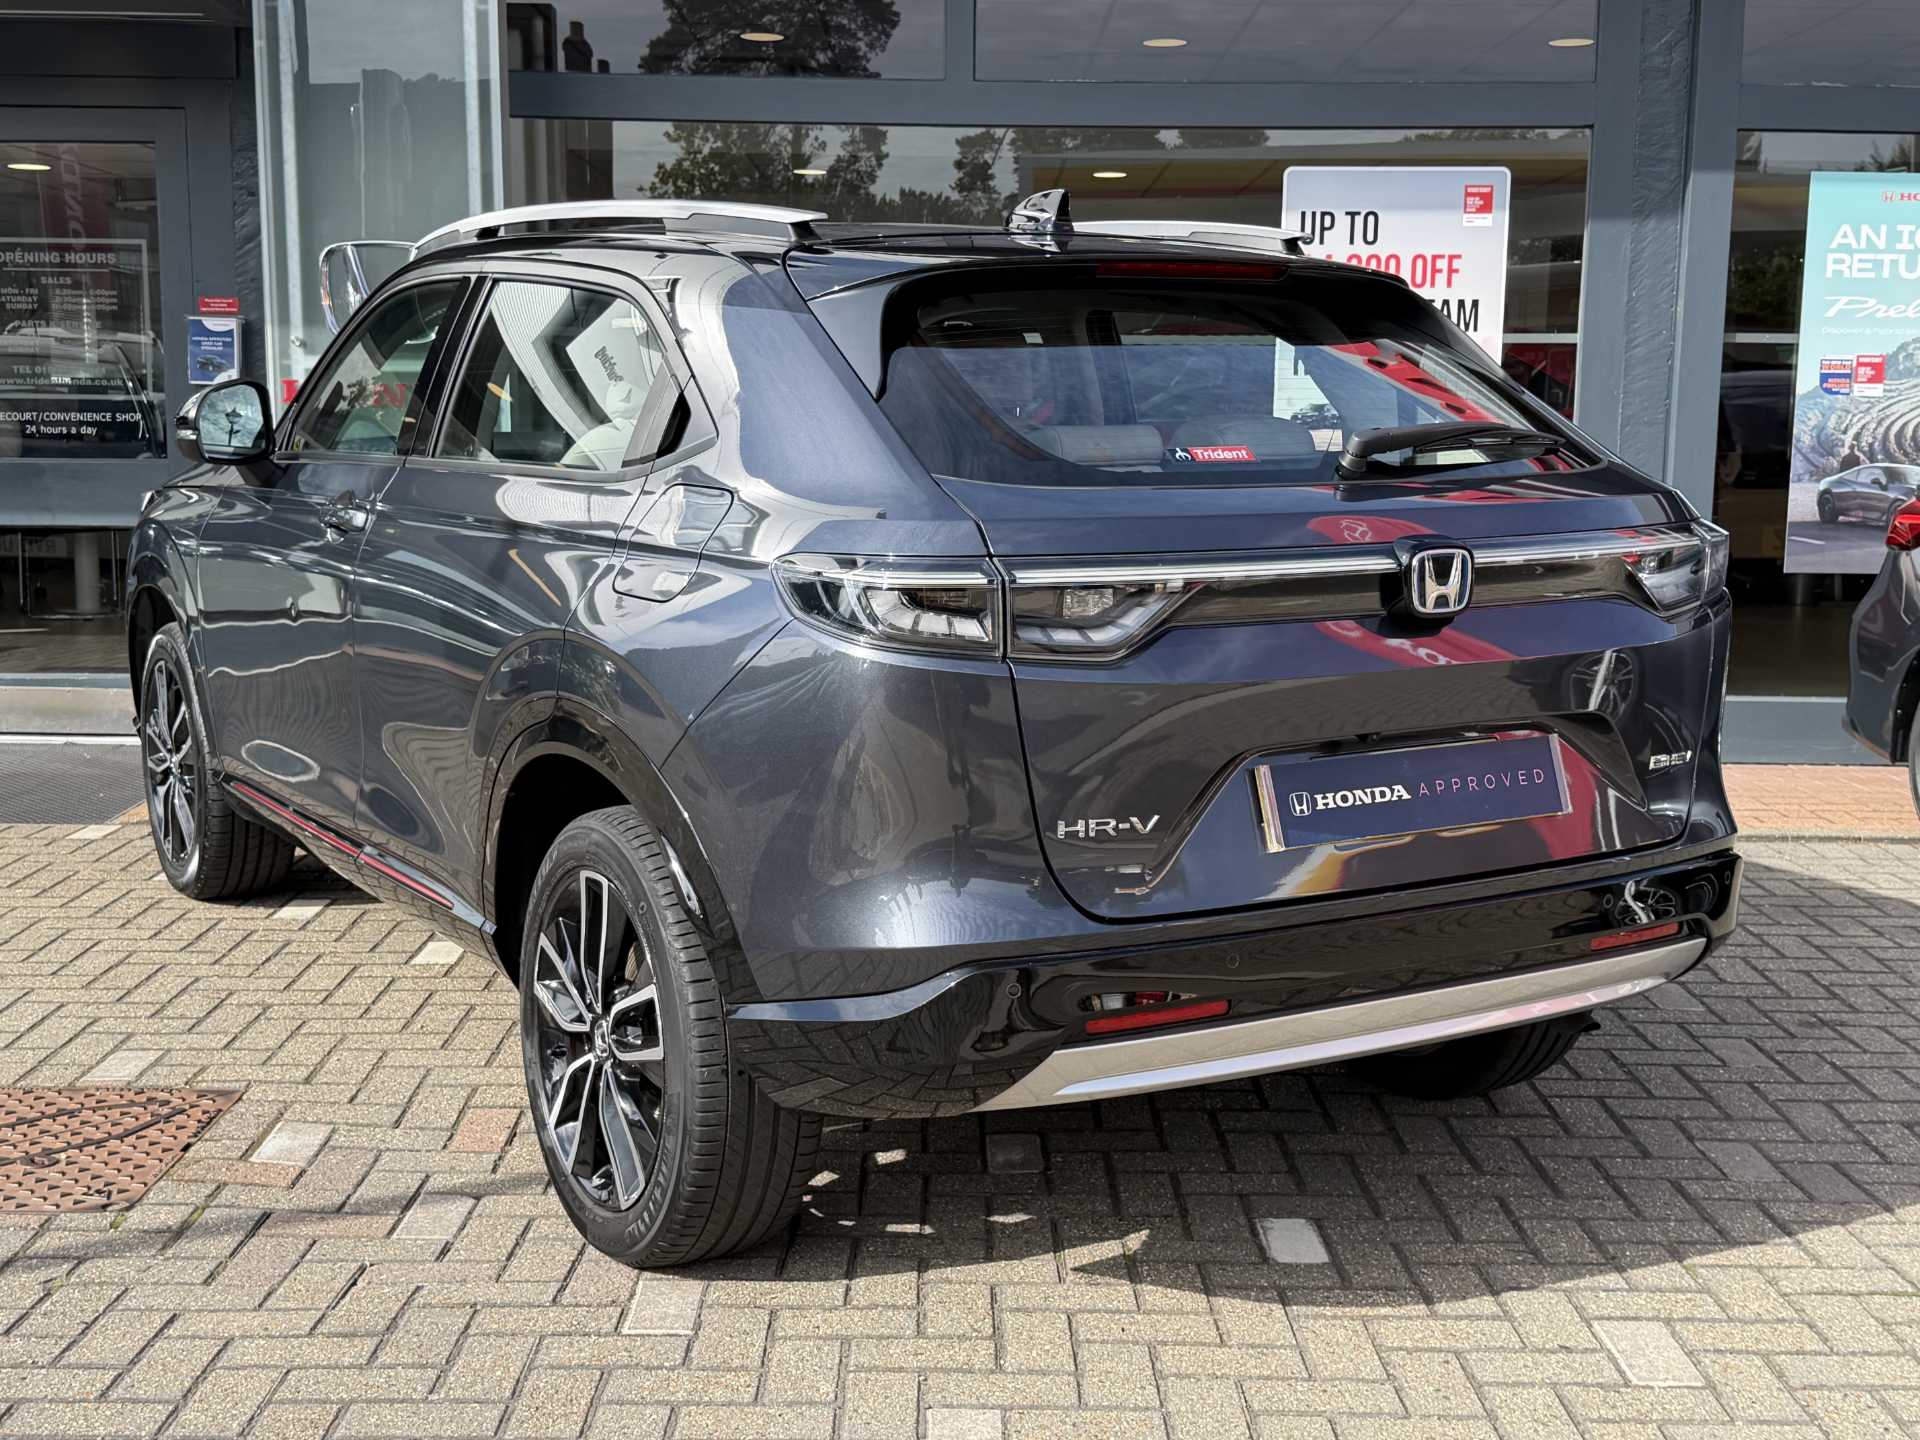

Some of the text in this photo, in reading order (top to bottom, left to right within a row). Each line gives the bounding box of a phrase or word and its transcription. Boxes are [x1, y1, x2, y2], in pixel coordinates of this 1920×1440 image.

[1300, 211, 1380, 246] UP TO
[1828, 223, 1888, 250] AN
[65, 252, 118, 265] HOURS
[40, 276, 73, 285] SALES
[1410, 254, 1463, 289] OFF
[1423, 298, 1480, 333] AM
[115, 412, 142, 423] SHOP
[25, 424, 98, 437] 24 hours a day
[1193, 448, 1249, 460] Trident
[1314, 784, 1412, 811] HONDA
[1418, 768, 1545, 798] APPROVED
[1057, 814, 1161, 839] HR-V
